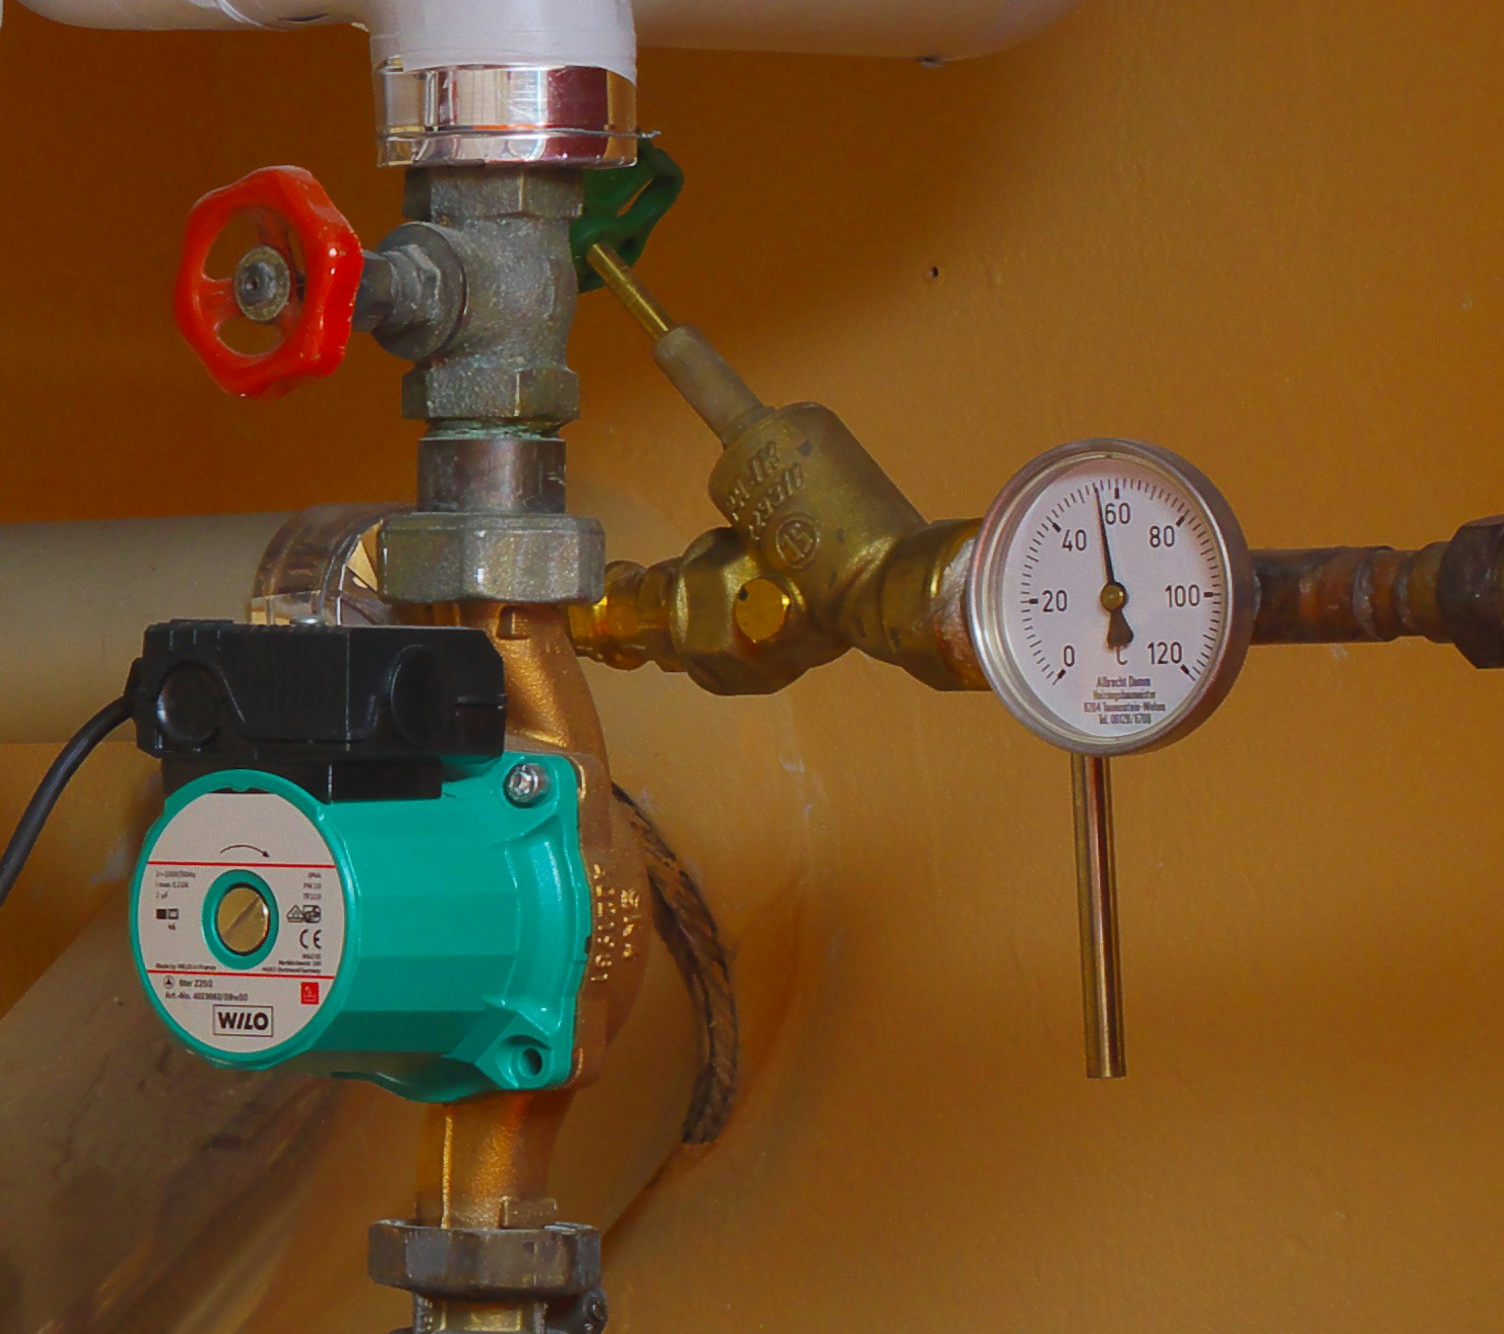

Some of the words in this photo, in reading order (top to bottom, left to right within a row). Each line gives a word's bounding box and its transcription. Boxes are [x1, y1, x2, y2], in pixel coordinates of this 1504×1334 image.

[1104, 502, 1131, 526] 60
[1061, 529, 1088, 551] 40
[1149, 525, 1175, 548] 80
[1042, 590, 1068, 613] 20
[1165, 585, 1199, 608] 100
[1063, 645, 1075, 667] 0
[1146, 641, 1182, 665] 120
[299, 929, 322, 949] CE
[217, 1011, 269, 1031] WILO
